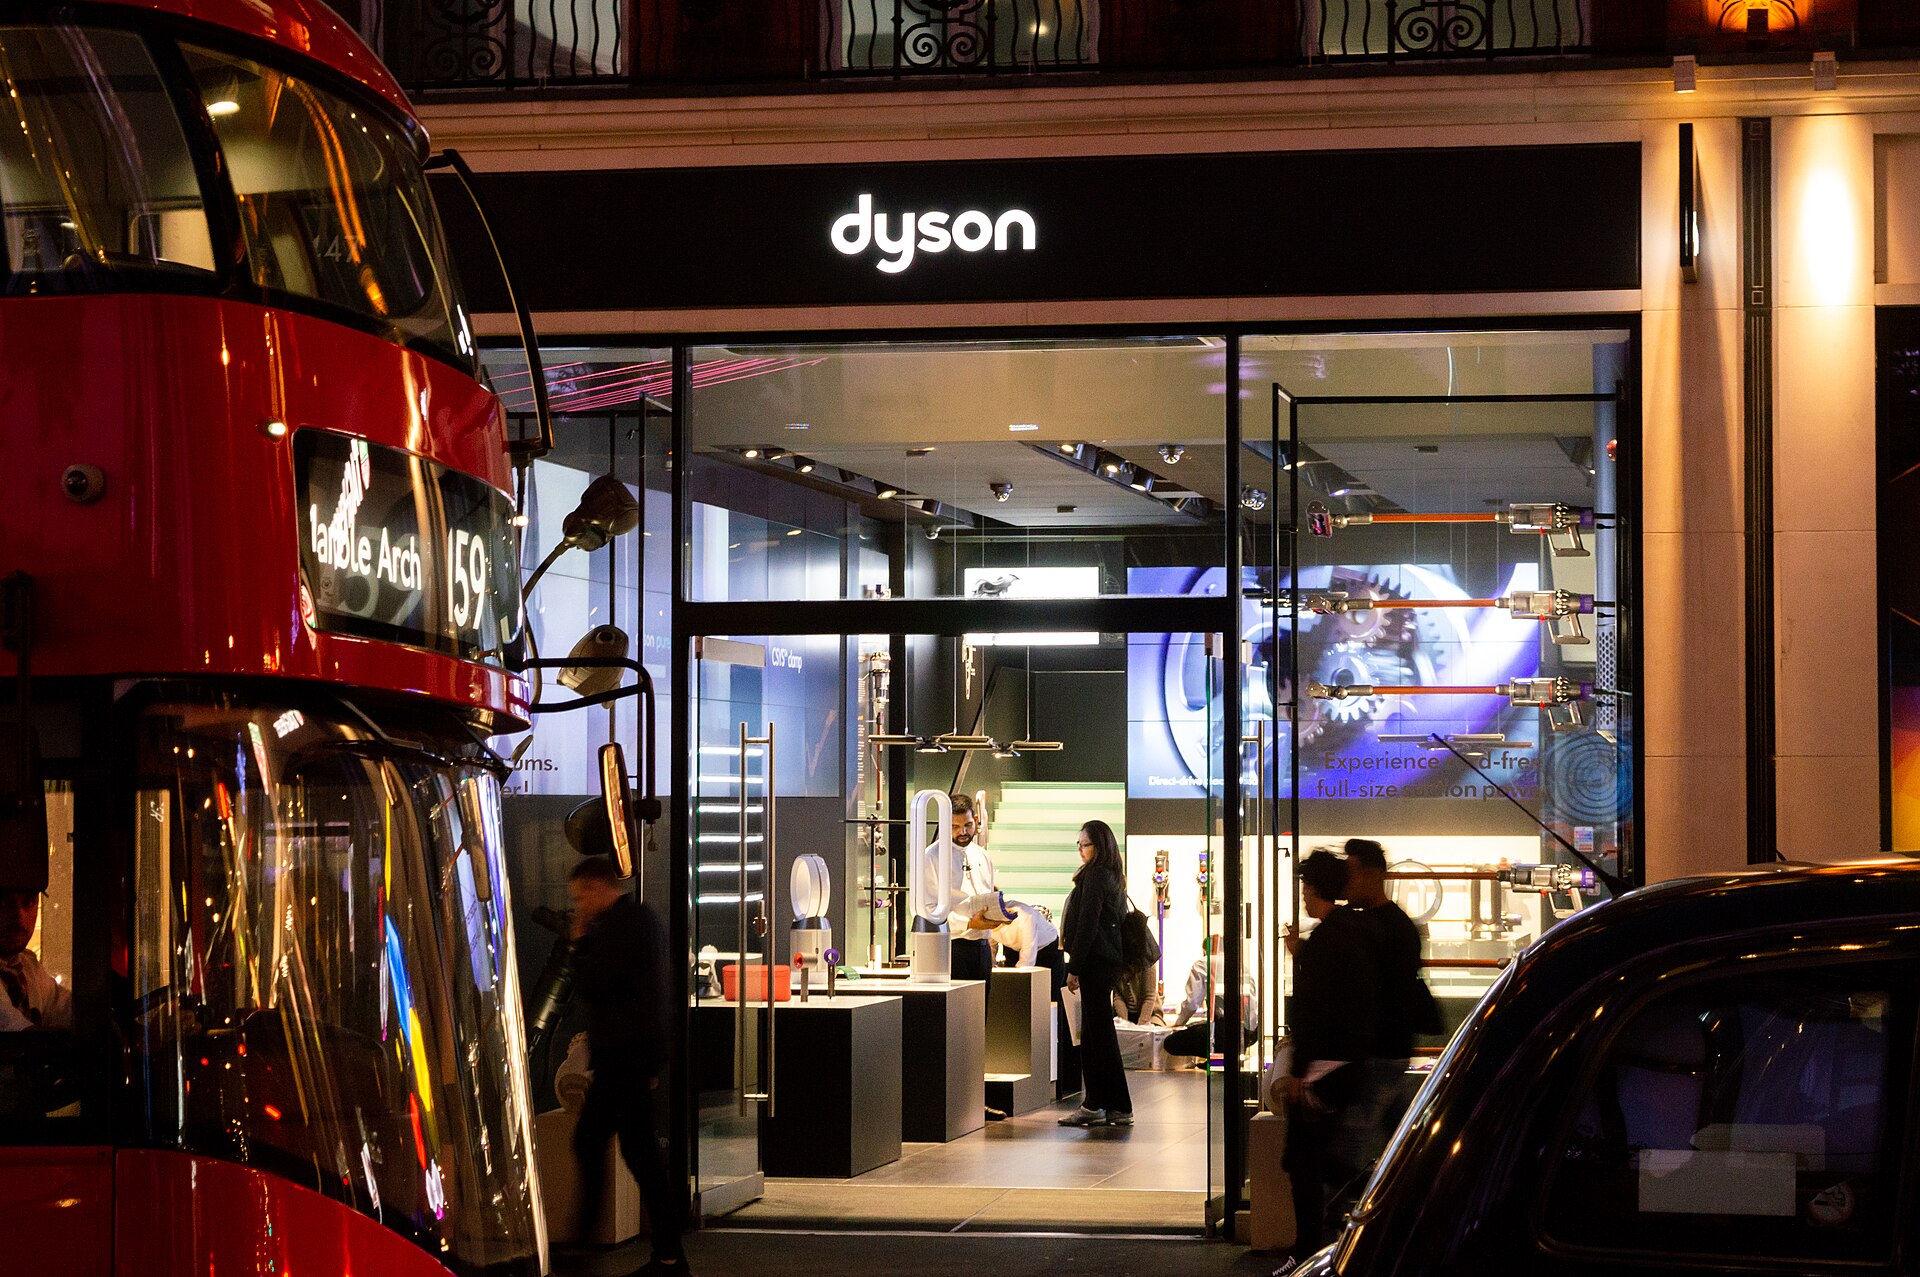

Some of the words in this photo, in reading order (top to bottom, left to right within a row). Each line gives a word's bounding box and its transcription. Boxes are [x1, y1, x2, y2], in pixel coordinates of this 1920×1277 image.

[831, 194, 1036, 274] dyson
[377, 527, 422, 590] Arch
[447, 527, 486, 630] 159
[1317, 779, 1398, 798] full-size
[1324, 752, 1440, 774] Experience
